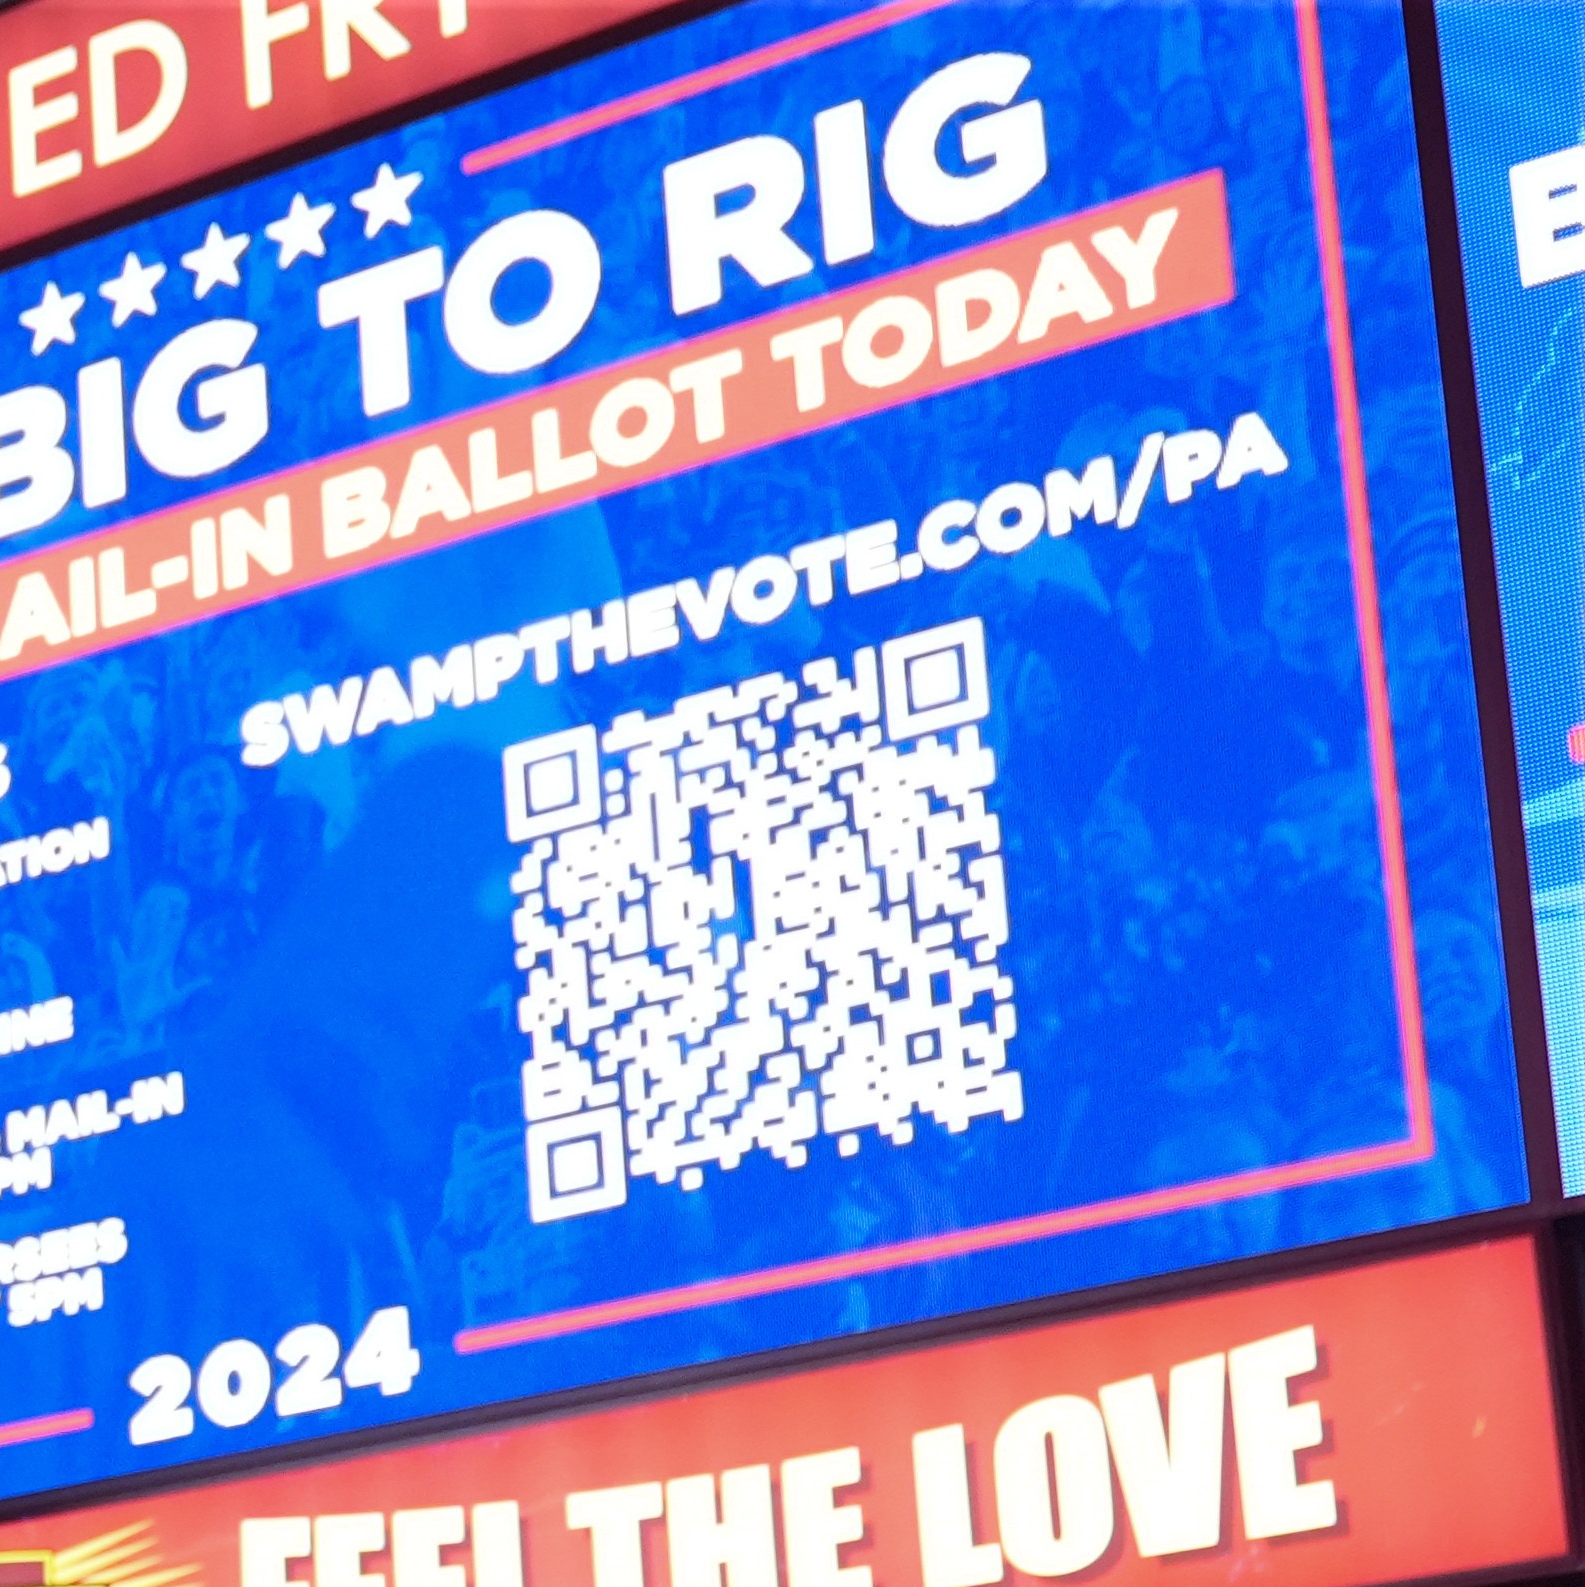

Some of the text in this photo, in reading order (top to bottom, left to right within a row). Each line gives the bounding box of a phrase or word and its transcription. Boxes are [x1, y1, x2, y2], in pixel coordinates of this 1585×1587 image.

[8, 0, 469, 198] ED FR
[318, 208, 602, 418] TO
[661, 50, 1049, 316] RIG
[321, 350, 743, 559] BALLOT
[770, 208, 1182, 412] TODAY
[240, 411, 1288, 767] SWAMPTHEVOTE.COM/PA
[6, 1070, 185, 1155] MAIL-IN
[7, 1266, 104, 1328] 5PM
[127, 1303, 422, 1446] 2024
